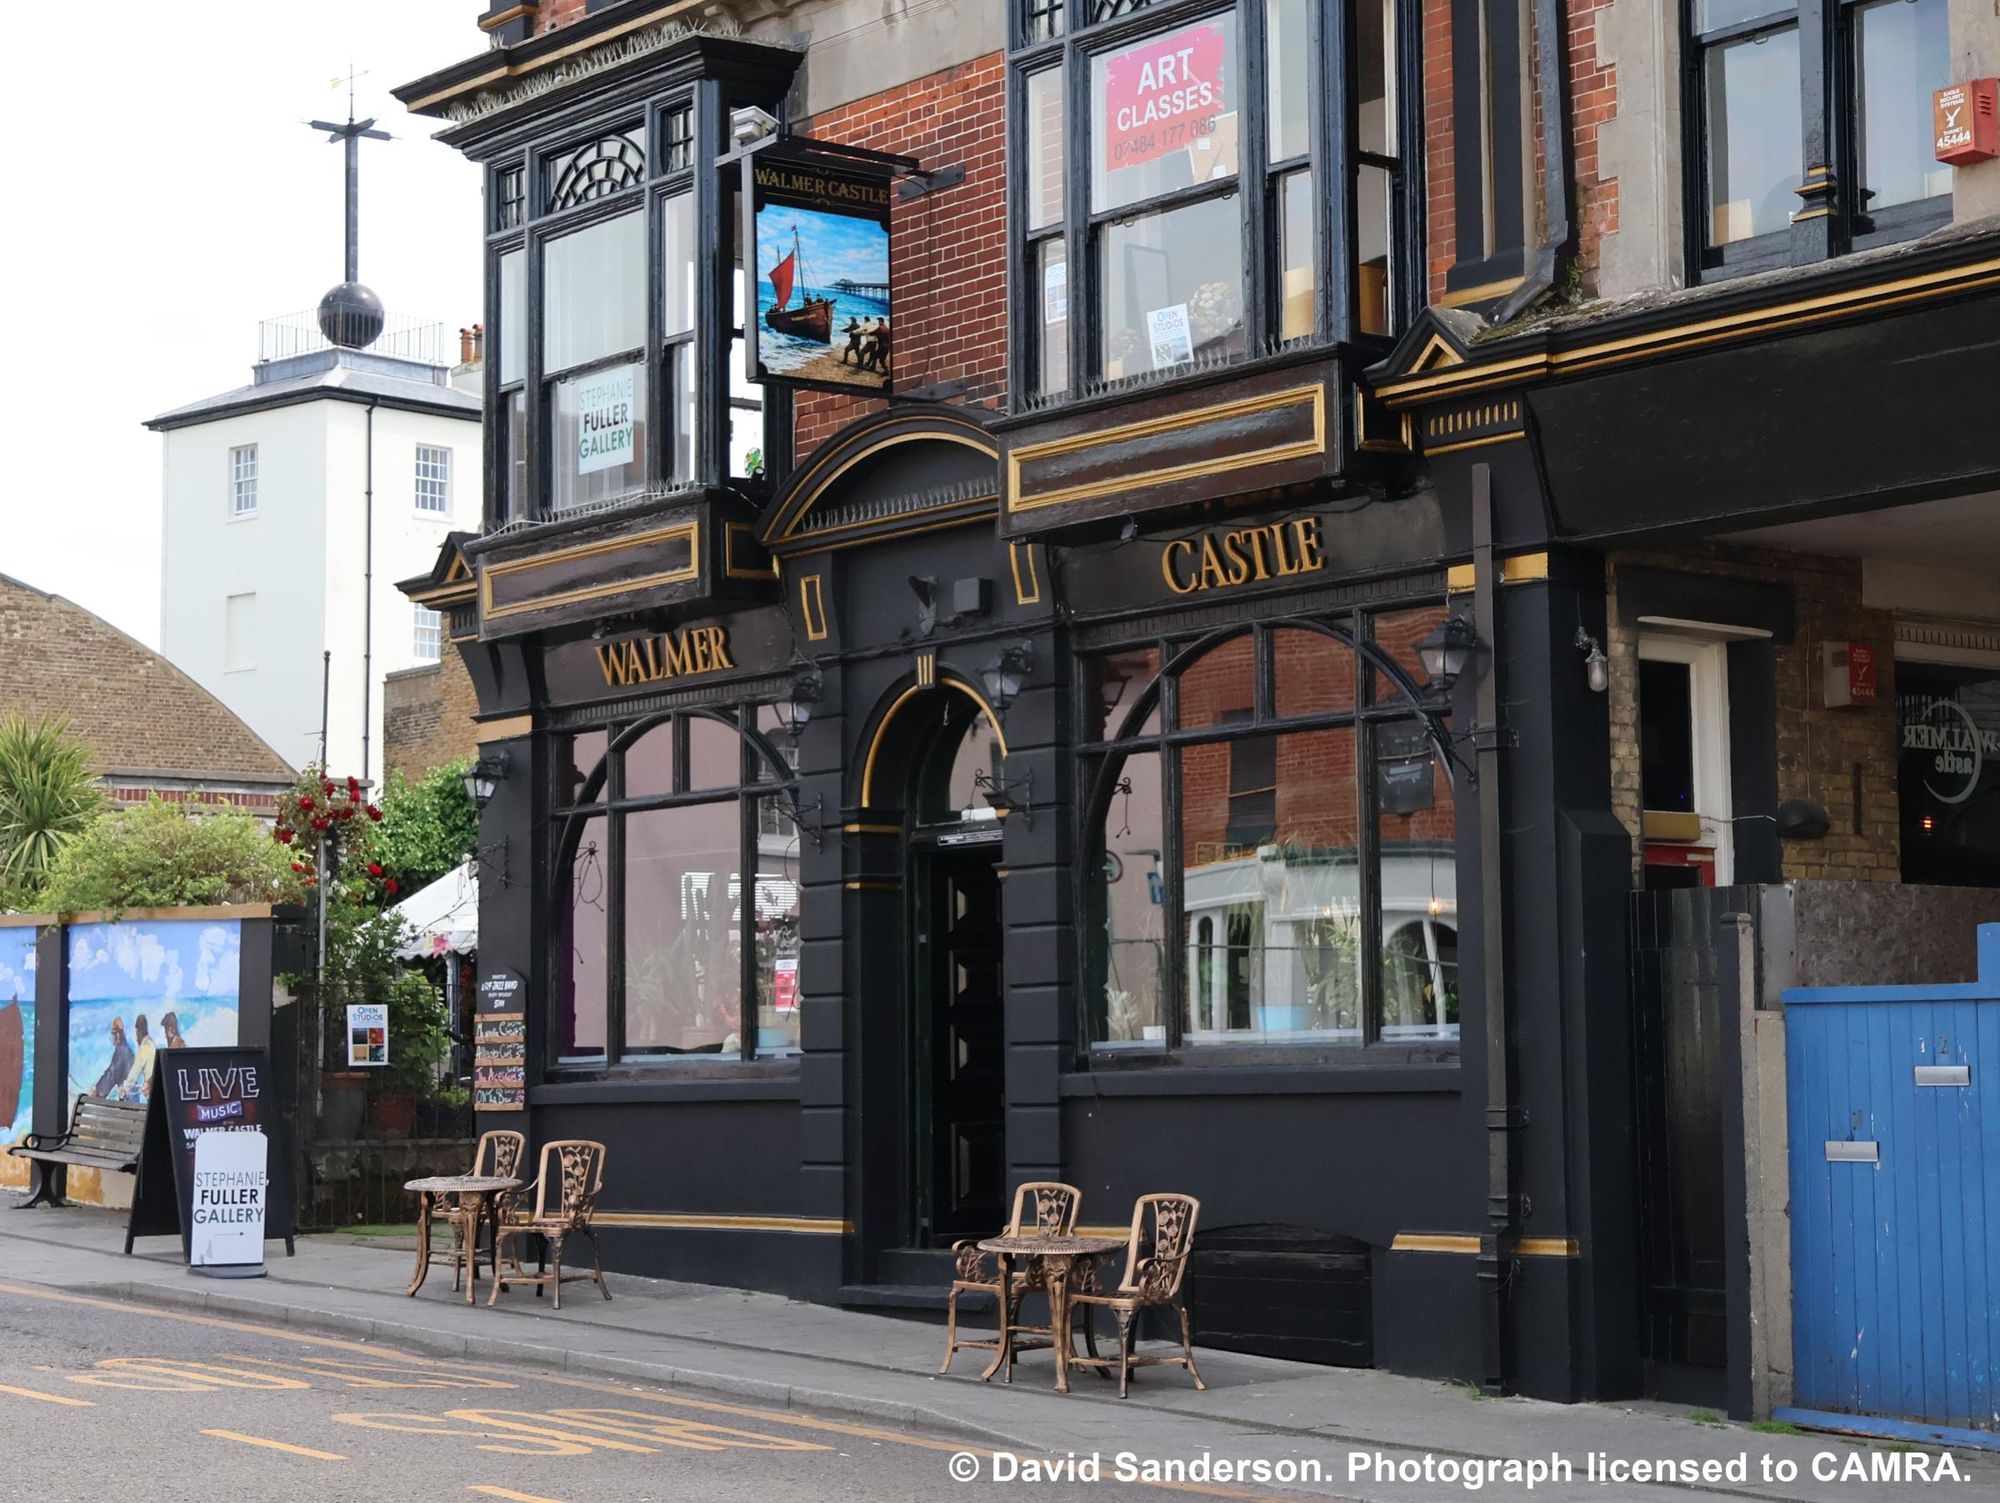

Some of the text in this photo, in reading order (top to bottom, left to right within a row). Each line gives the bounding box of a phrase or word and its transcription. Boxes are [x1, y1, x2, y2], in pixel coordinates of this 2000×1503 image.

[1137, 47, 1194, 96] ART
[1117, 81, 1213, 132] CLASSES
[1163, 123, 1186, 146] 177
[1190, 113, 1217, 139] 086
[1936, 130, 1971, 148] 45444
[754, 167, 889, 204] WALMER CASTLE
[579, 378, 633, 411] STEPHANIE
[584, 403, 628, 433] FULLER
[579, 427, 633, 459] GALLERY
[1162, 516, 1324, 594] CASTLE
[594, 626, 734, 687] WALMER
[357, 1006, 378, 1015] OPEN
[177, 1066, 260, 1101] LIVE
[201, 1103, 239, 1120] MUSIC
[195, 1171, 265, 1188] STEPHANIE
[200, 1188, 259, 1206] FULLER
[193, 1207, 264, 1225] GALLERY
[329, 1408, 836, 1456] BUS
